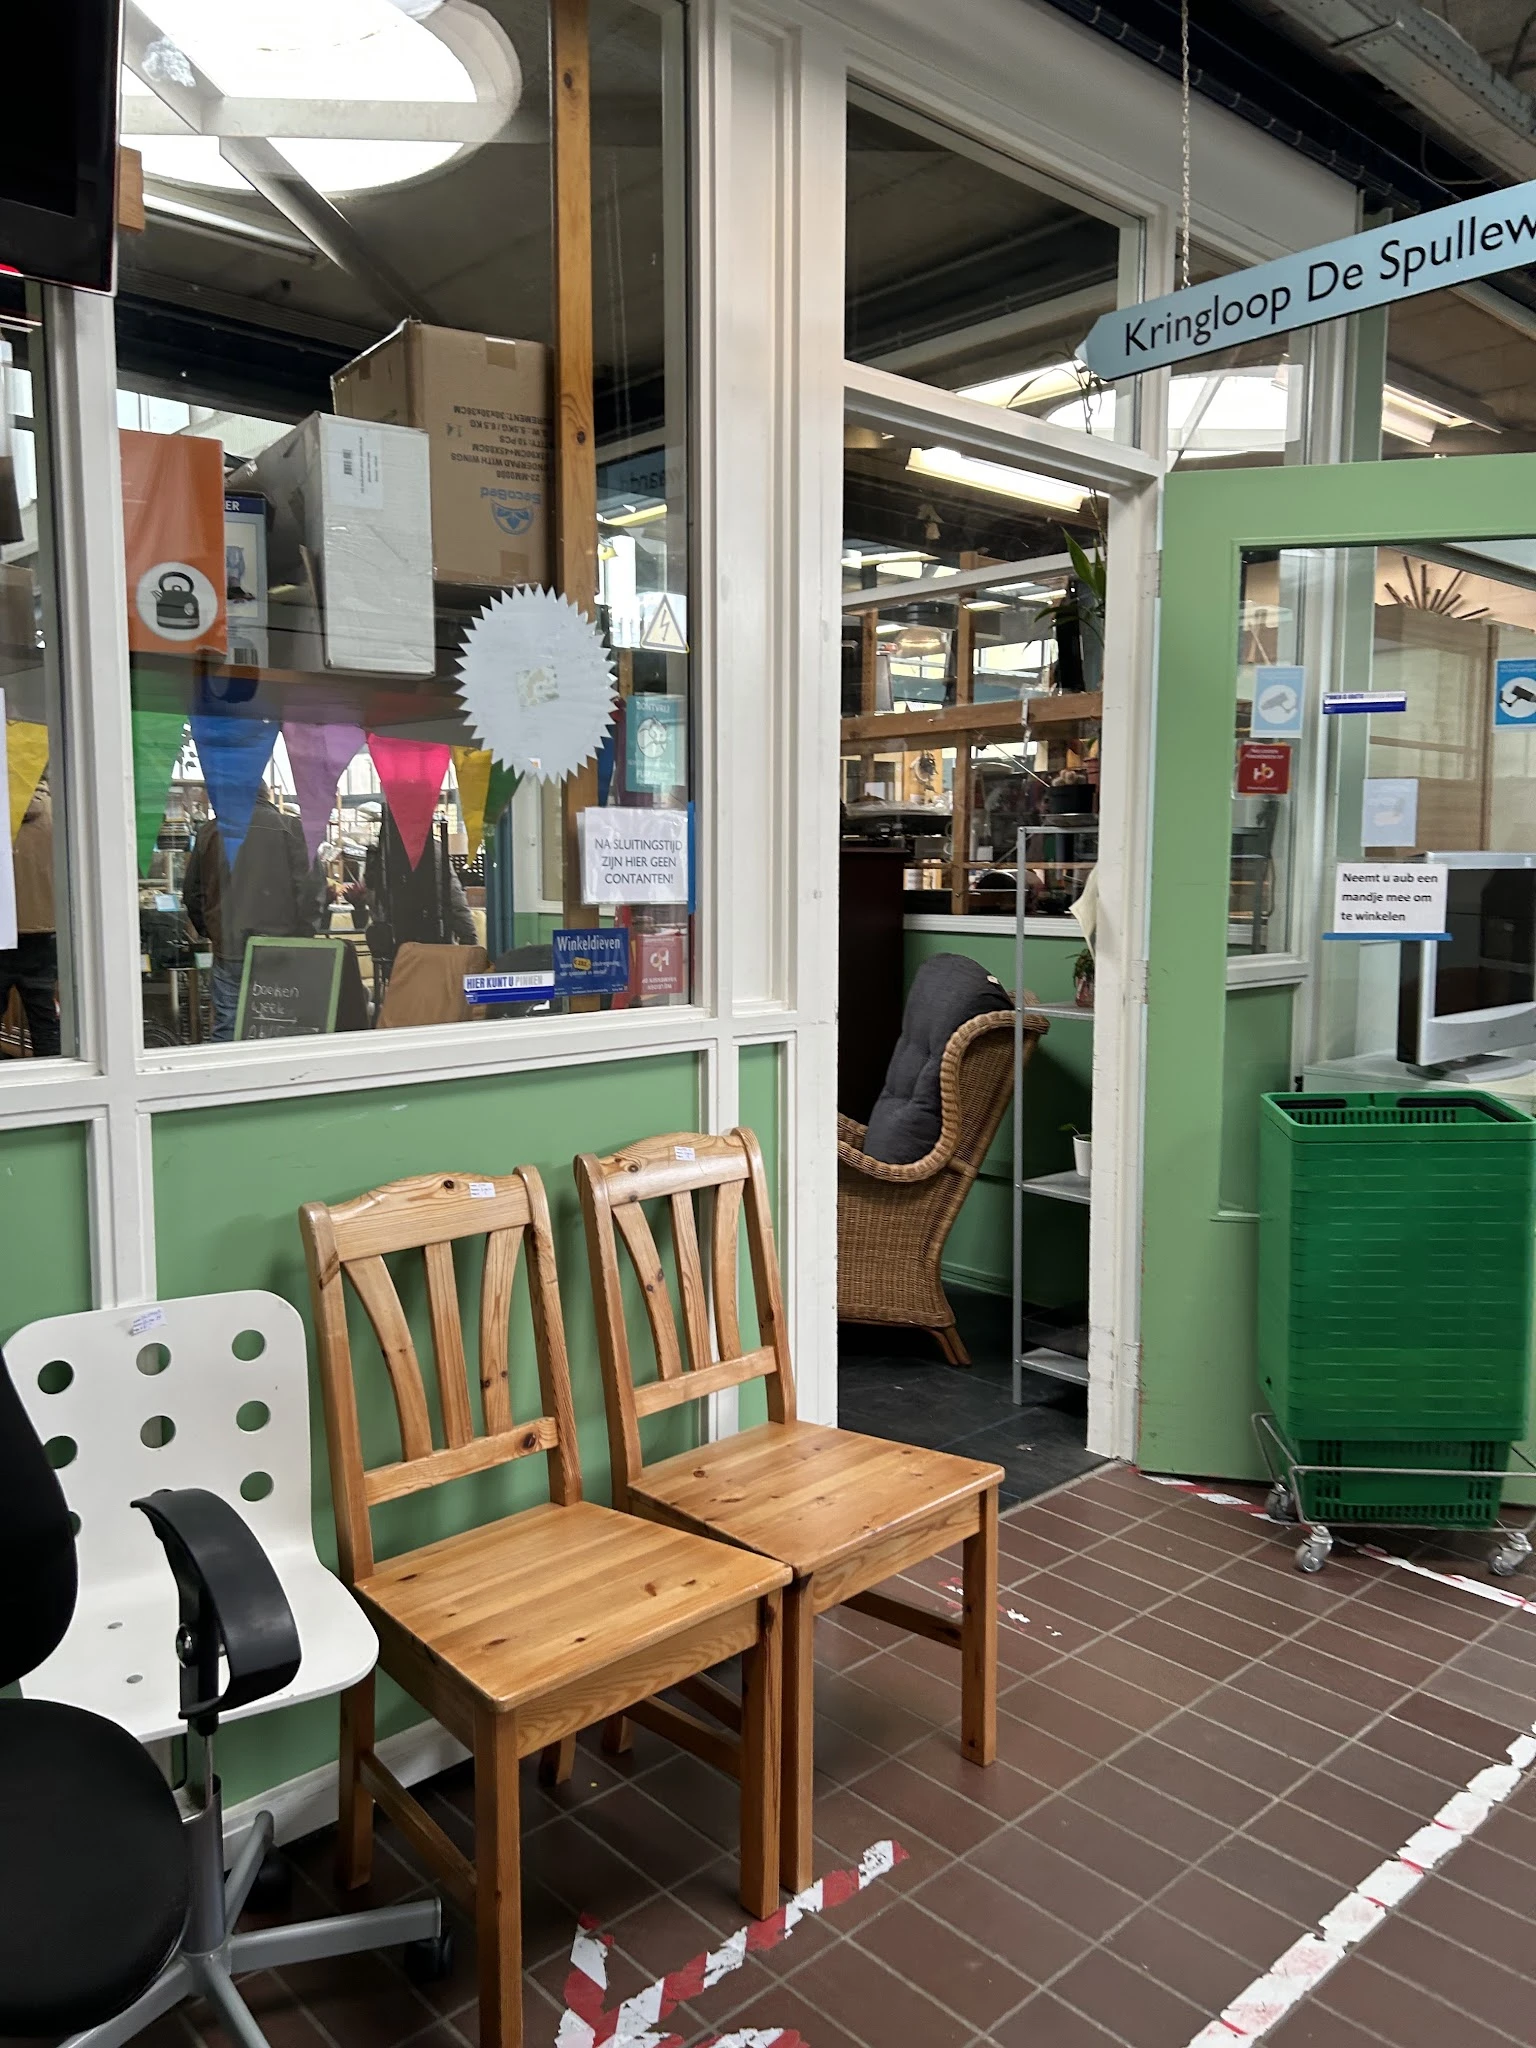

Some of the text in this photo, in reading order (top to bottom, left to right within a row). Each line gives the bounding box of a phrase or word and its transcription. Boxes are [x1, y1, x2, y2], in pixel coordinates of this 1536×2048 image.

[1125, 213, 1536, 356] Kringloop De Spullew
[481, 457, 503, 467] WITH
[224, 500, 240, 512] ER
[595, 839, 683, 854] NA SLUITINGSTIJD
[601, 856, 677, 870] ZIJN HIER GEEN
[604, 873, 674, 884] CONTANTEN!
[1342, 873, 1438, 883] Neemt u aub een
[1341, 892, 1432, 904] mandje mee om
[1340, 911, 1406, 921] te winkelen
[556, 935, 620, 951] Winkeldieven
[467, 977, 485, 989] HIER
[486, 976, 508, 988] KUNT
[508, 976, 514, 987] U
